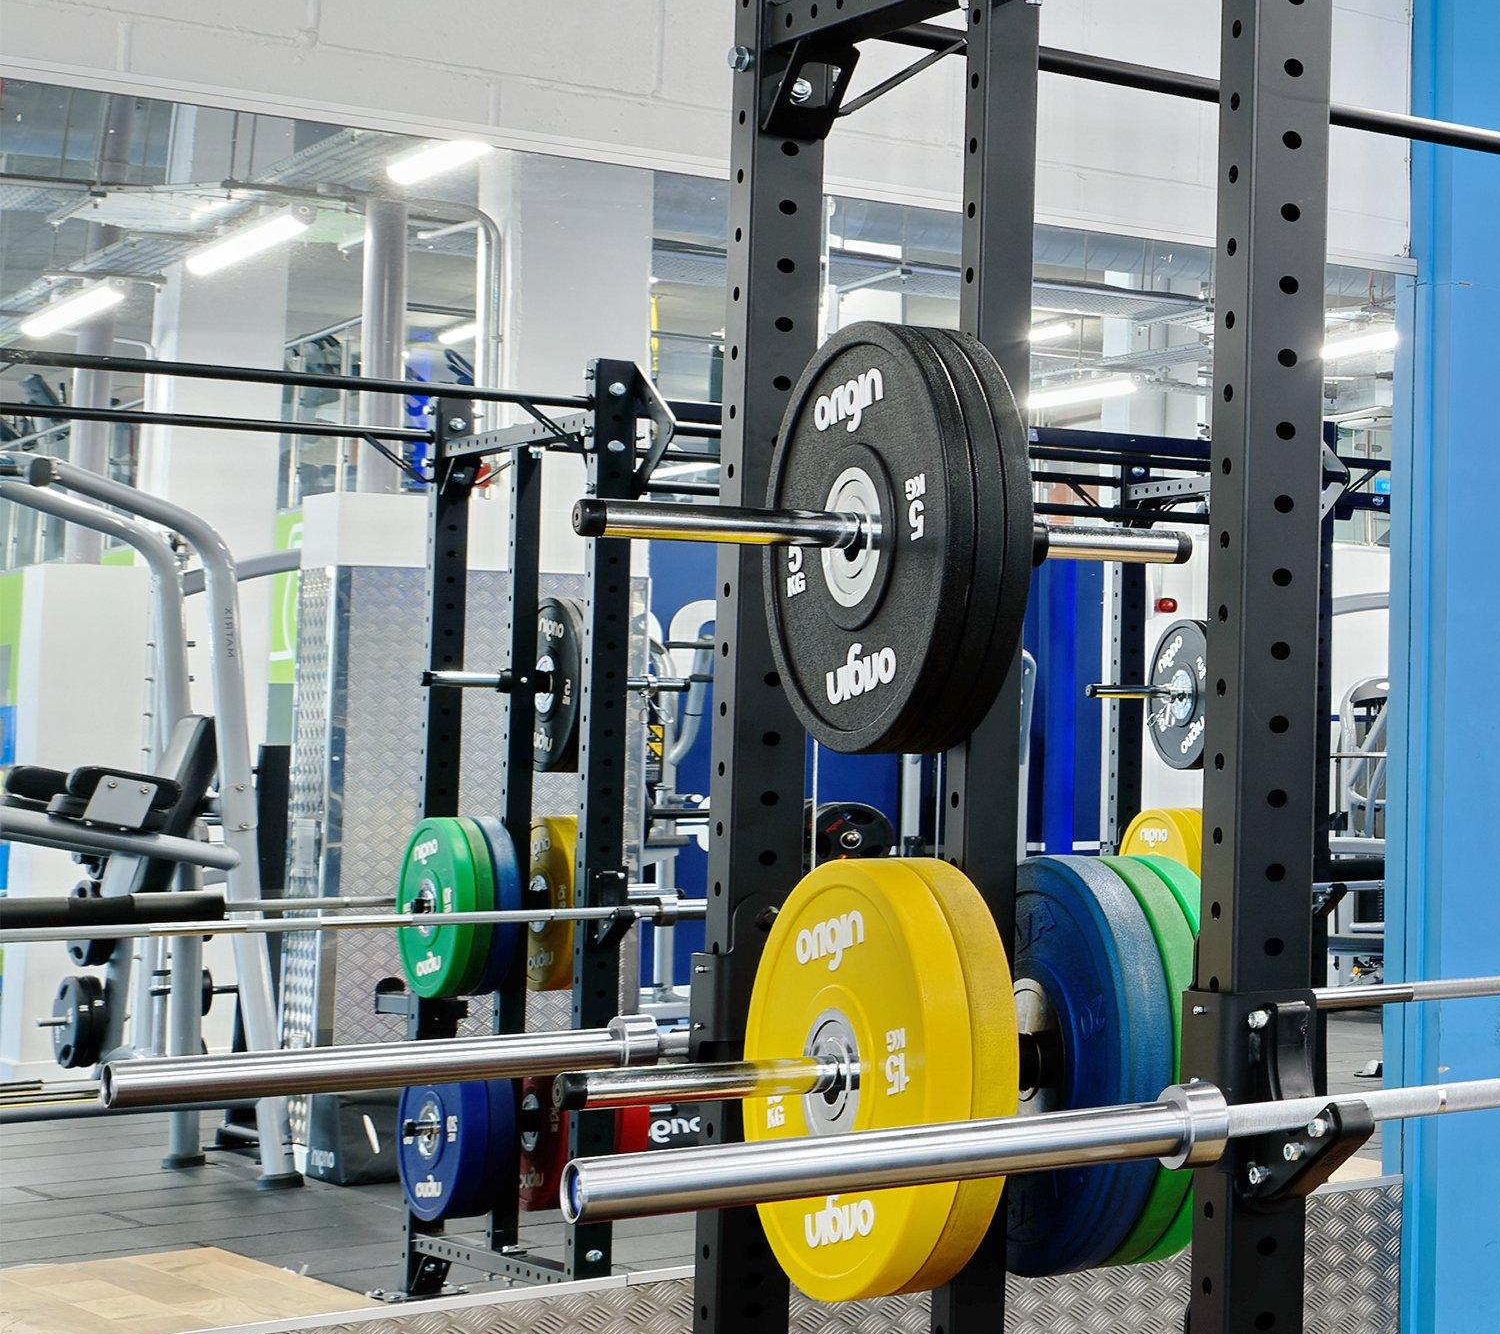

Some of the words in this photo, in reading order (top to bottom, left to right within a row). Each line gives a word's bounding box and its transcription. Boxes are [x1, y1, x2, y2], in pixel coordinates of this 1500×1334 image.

[814, 368, 884, 433] origin
[904, 473, 925, 499] KG
[908, 502, 925, 541] 5
[786, 573, 806, 597] KG
[826, 644, 897, 706] origin
[795, 910, 864, 971] origin
[886, 1027, 906, 1053] KG
[886, 1054, 908, 1095] 15
[767, 1105, 786, 1129] KG
[804, 1194, 874, 1249] origin
